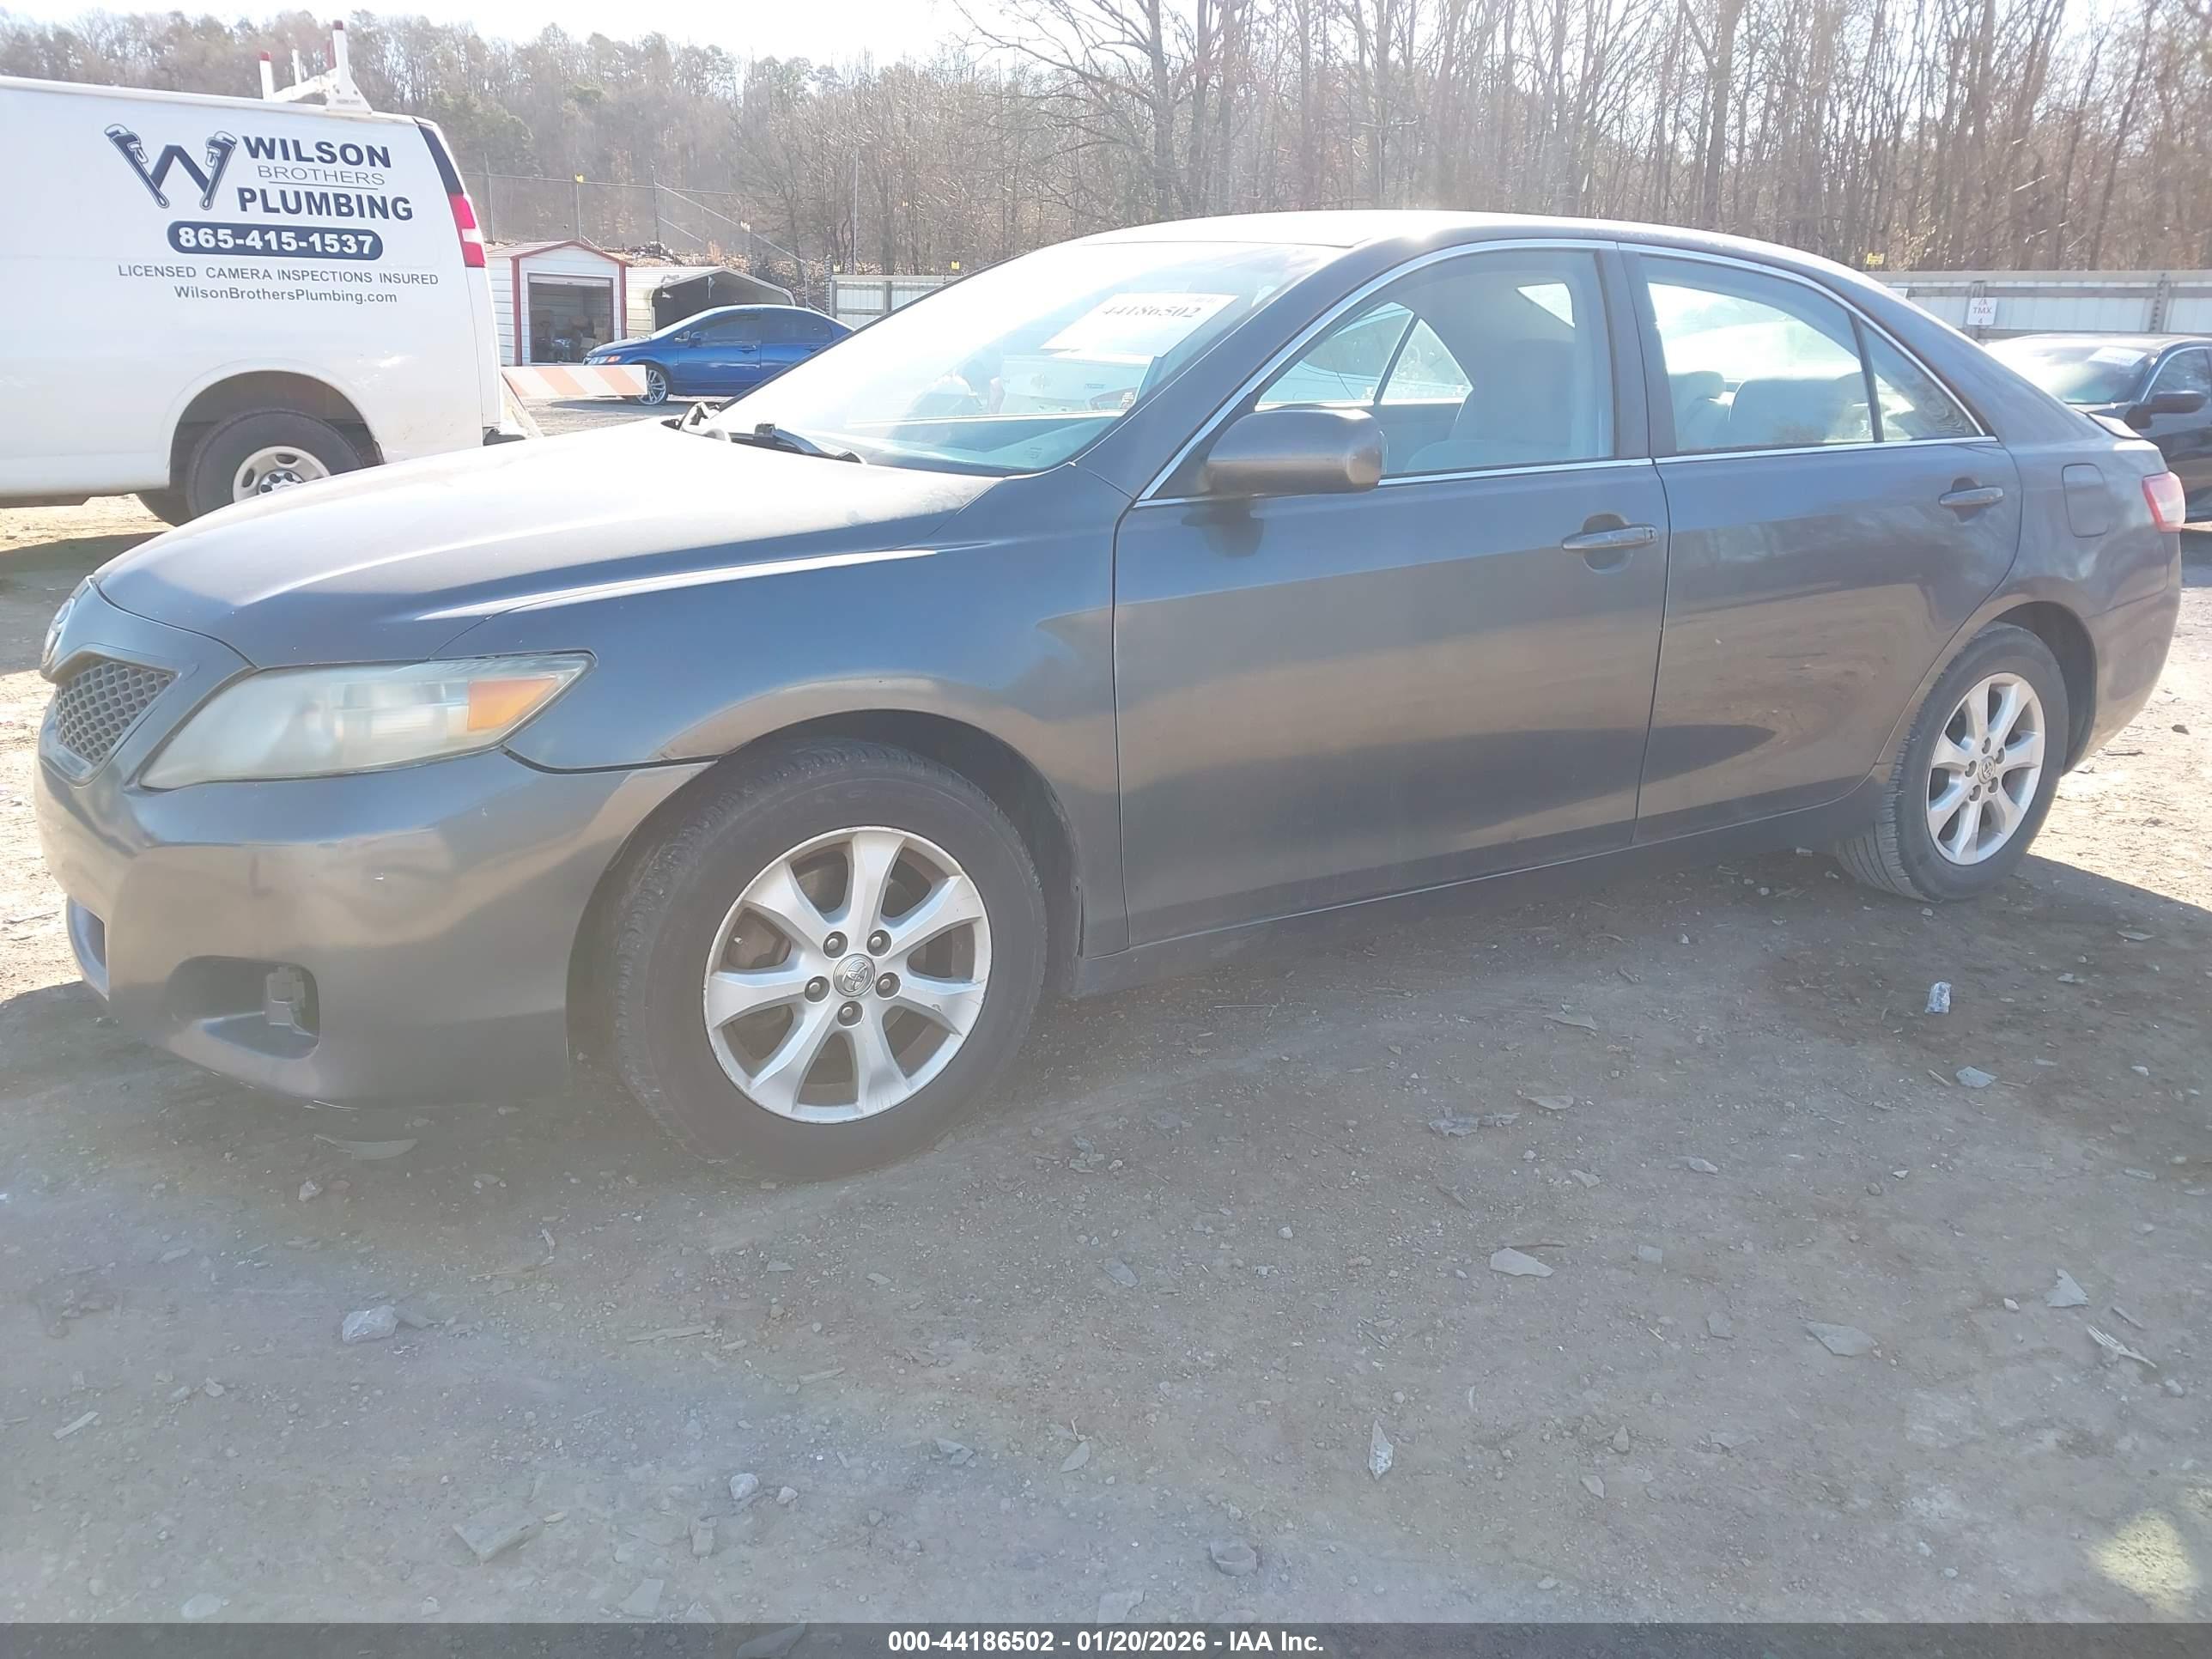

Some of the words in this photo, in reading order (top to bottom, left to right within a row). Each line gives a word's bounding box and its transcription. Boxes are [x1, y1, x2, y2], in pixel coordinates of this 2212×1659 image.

[242, 135, 392, 168] WILSON
[257, 165, 386, 185] BROTHERS
[237, 187, 413, 221] PLUMBING
[177, 227, 374, 255] 865-415-1537
[118, 264, 197, 279] LICENSED
[205, 266, 273, 281] CAMERA
[277, 269, 373, 284] INSPECTIONS
[379, 271, 439, 286] INSURED
[174, 285, 398, 305] WilsonBrothersPlumbing.com
